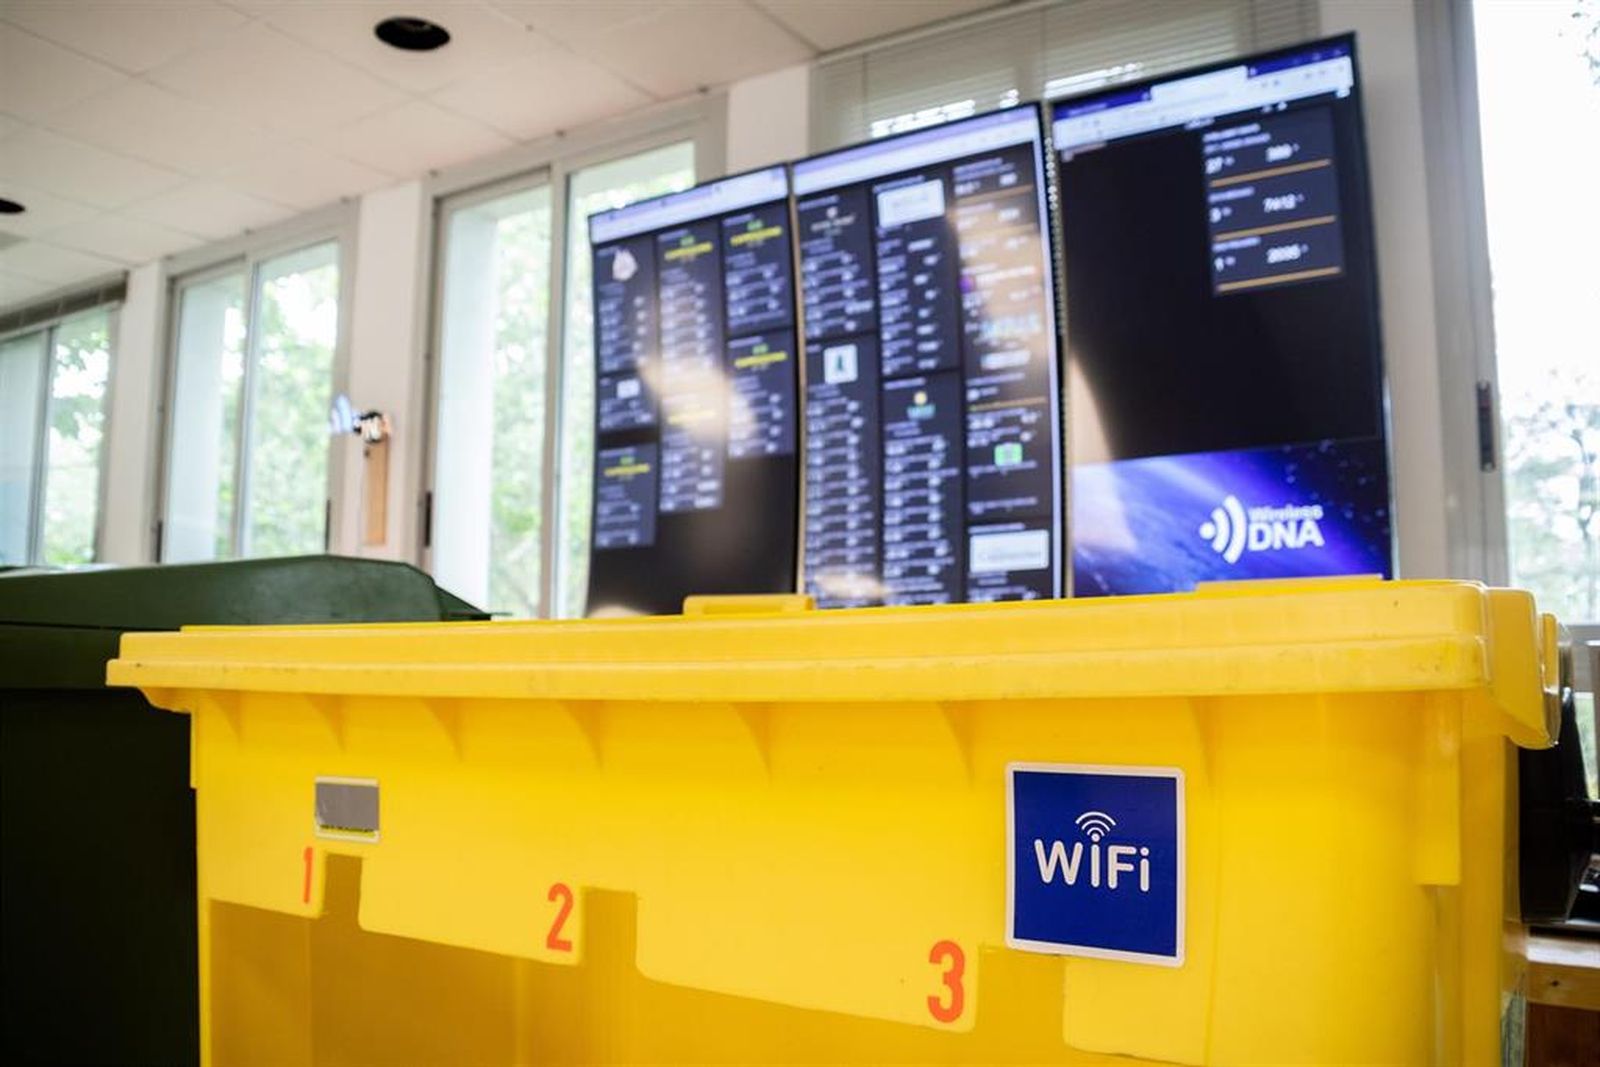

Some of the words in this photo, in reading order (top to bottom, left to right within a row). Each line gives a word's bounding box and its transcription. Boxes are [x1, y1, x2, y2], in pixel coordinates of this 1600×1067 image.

[1248, 518, 1325, 551] DNA
[303, 846, 314, 904] 1
[546, 882, 574, 952] 2
[927, 940, 965, 1023] 3
